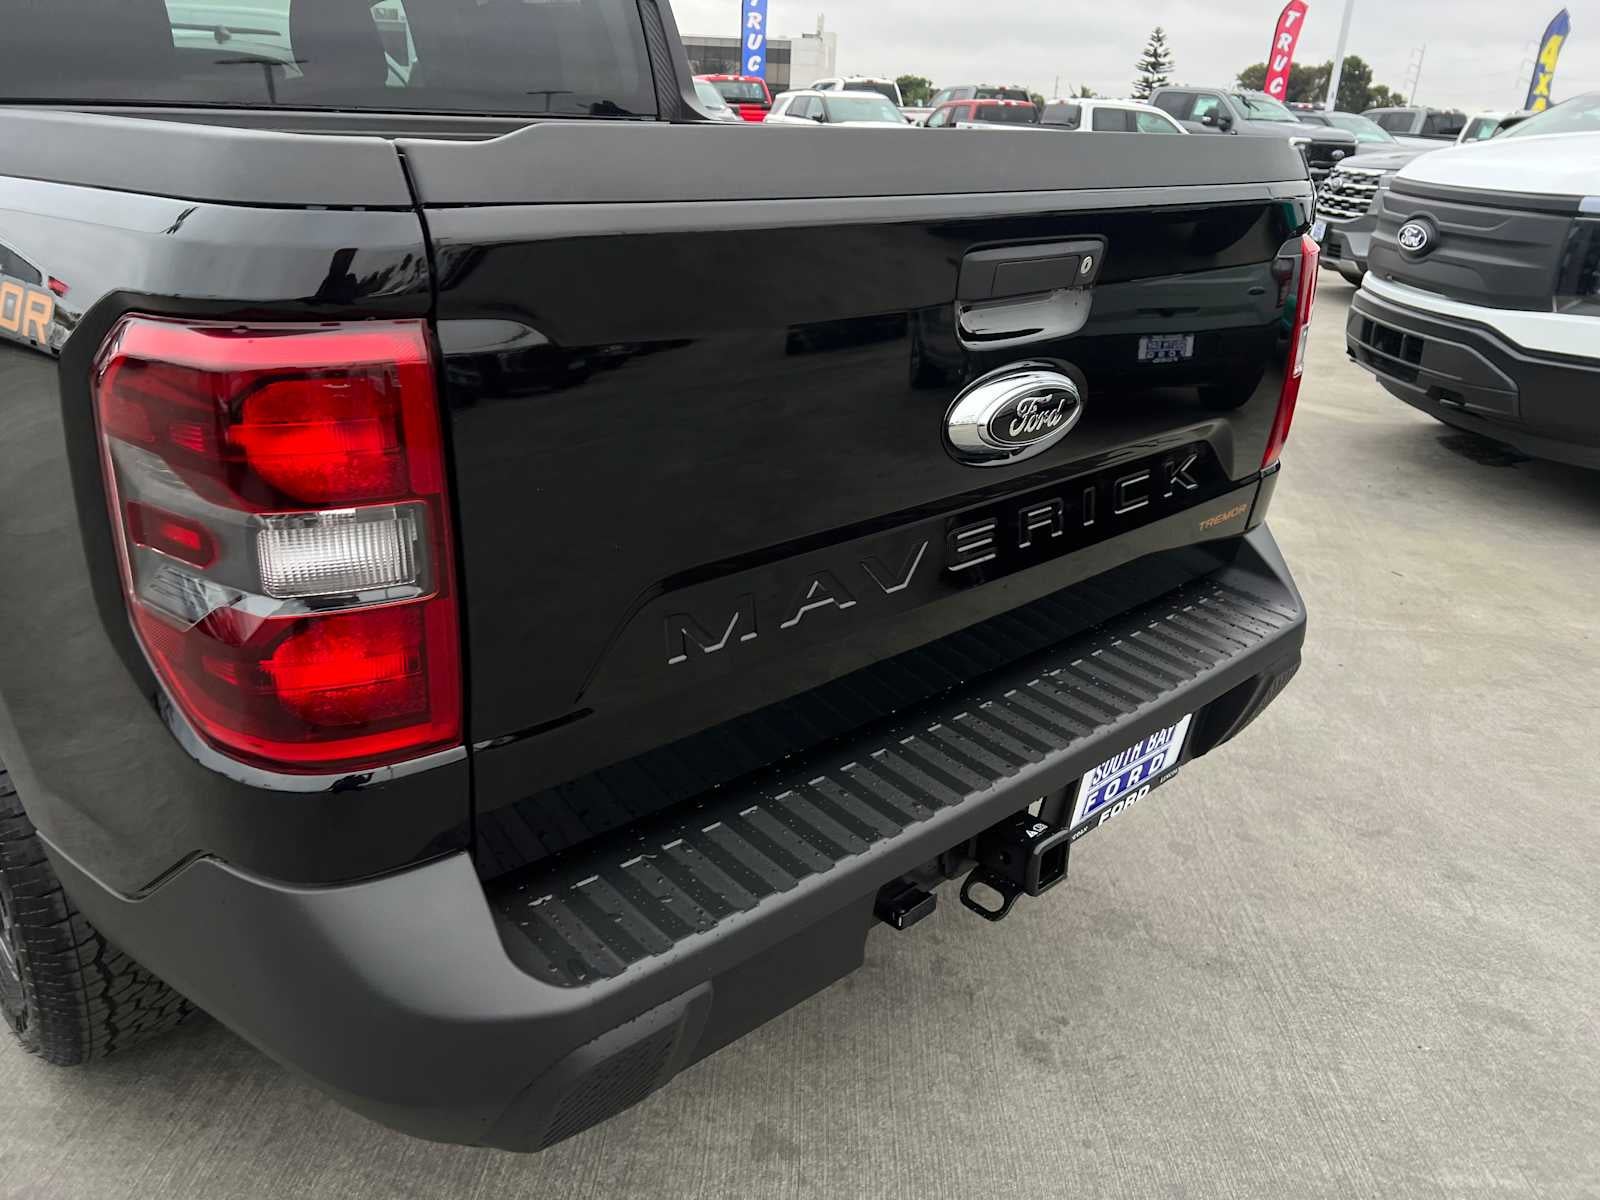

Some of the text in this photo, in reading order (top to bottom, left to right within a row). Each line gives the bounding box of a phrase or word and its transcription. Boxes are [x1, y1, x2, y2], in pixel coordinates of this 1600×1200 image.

[1009, 393, 1065, 437] Ford
[1199, 503, 1248, 530] TREMOR
[664, 452, 1198, 664] MAVERICK
[1083, 752, 1165, 816] FORD
[1097, 784, 1151, 828] FORD
